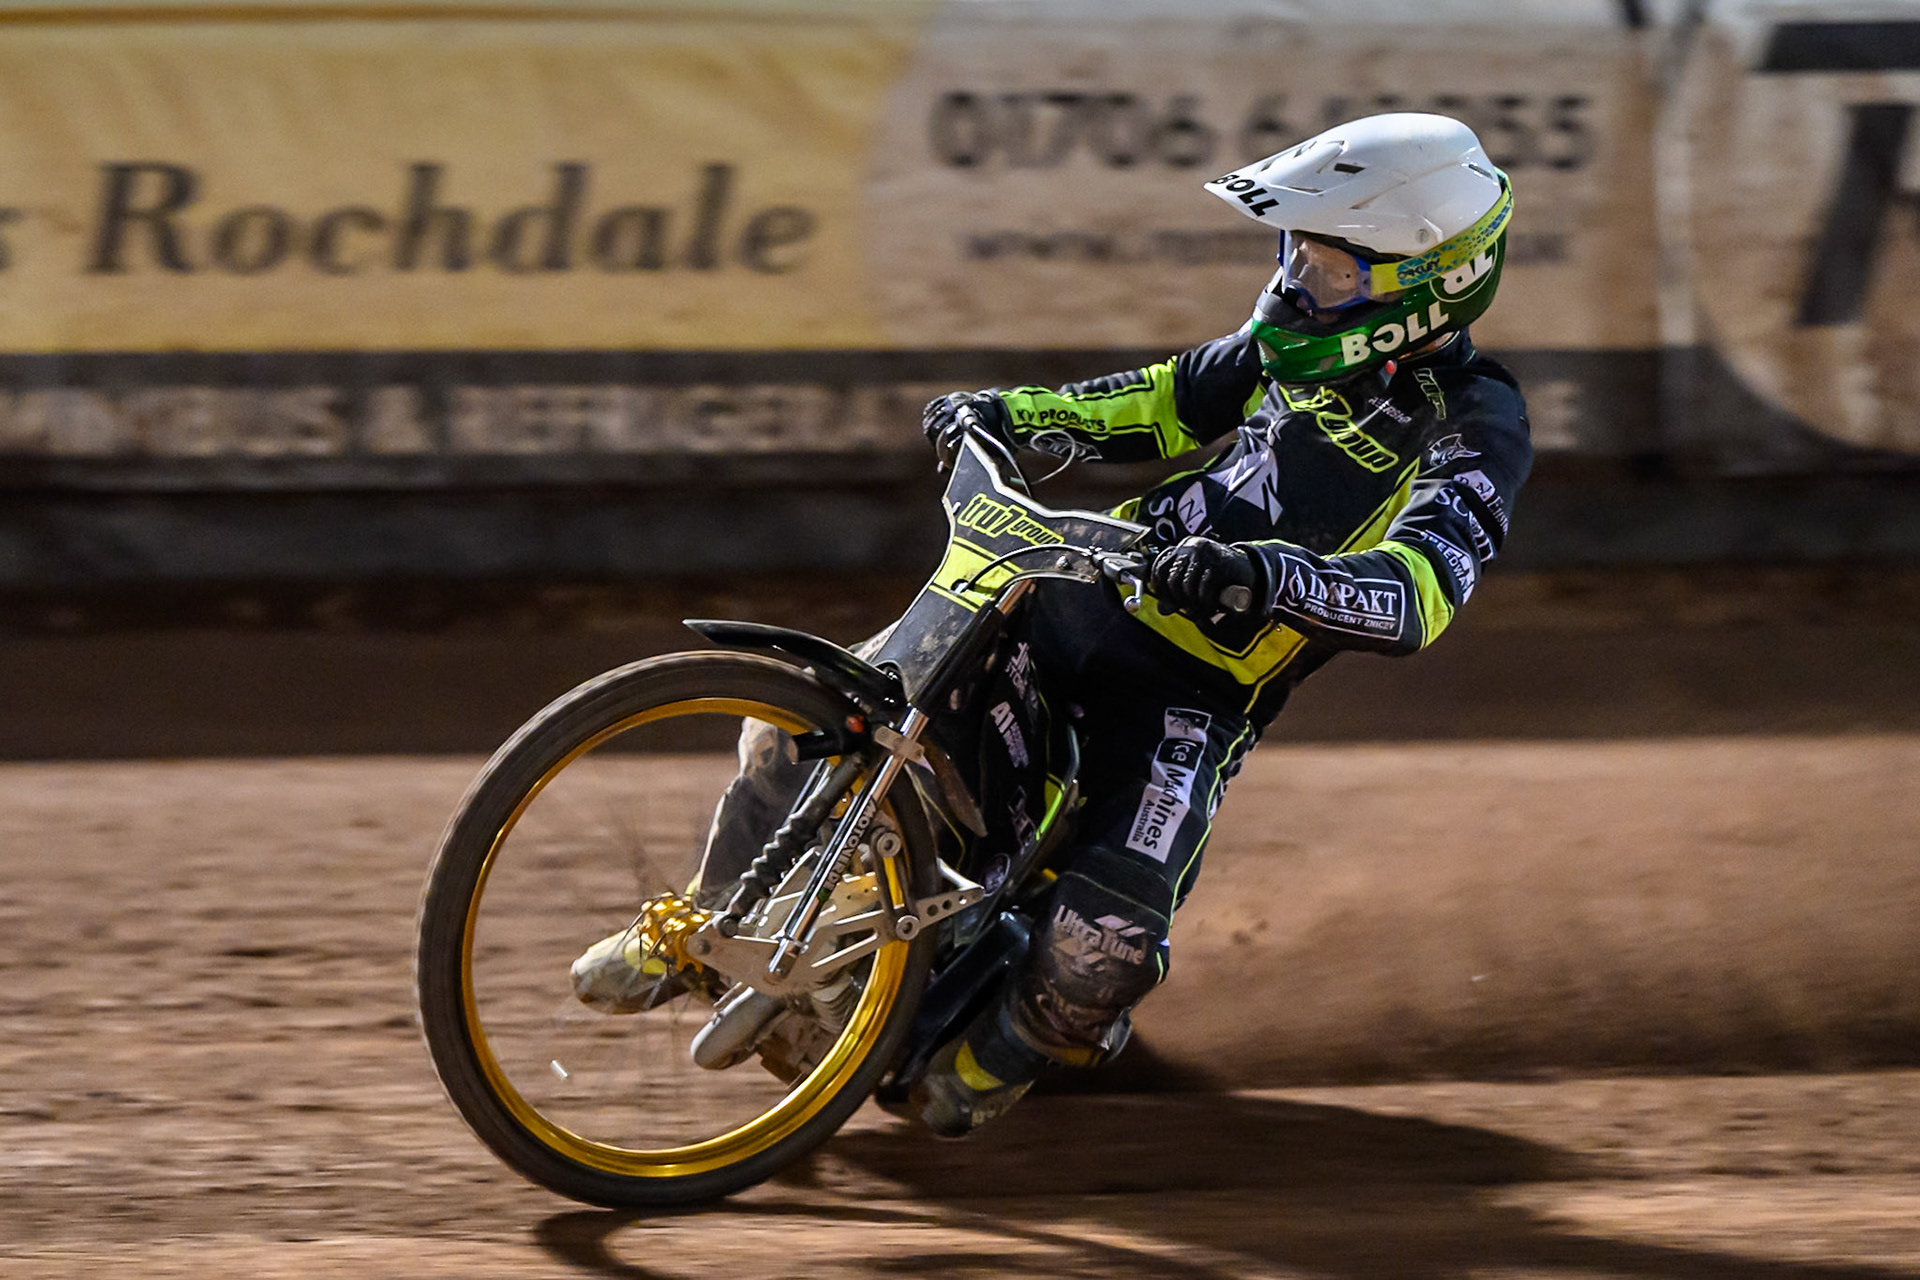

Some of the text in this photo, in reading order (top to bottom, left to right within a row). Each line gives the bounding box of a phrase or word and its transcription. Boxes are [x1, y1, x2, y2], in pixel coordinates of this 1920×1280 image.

[1210, 174, 1280, 217] BOLL
[84, 159, 818, 277] Rochdale
[1341, 300, 1449, 366] BOLL
[1308, 573, 1397, 615] IMPAKT
[1131, 799, 1156, 843] Australia
